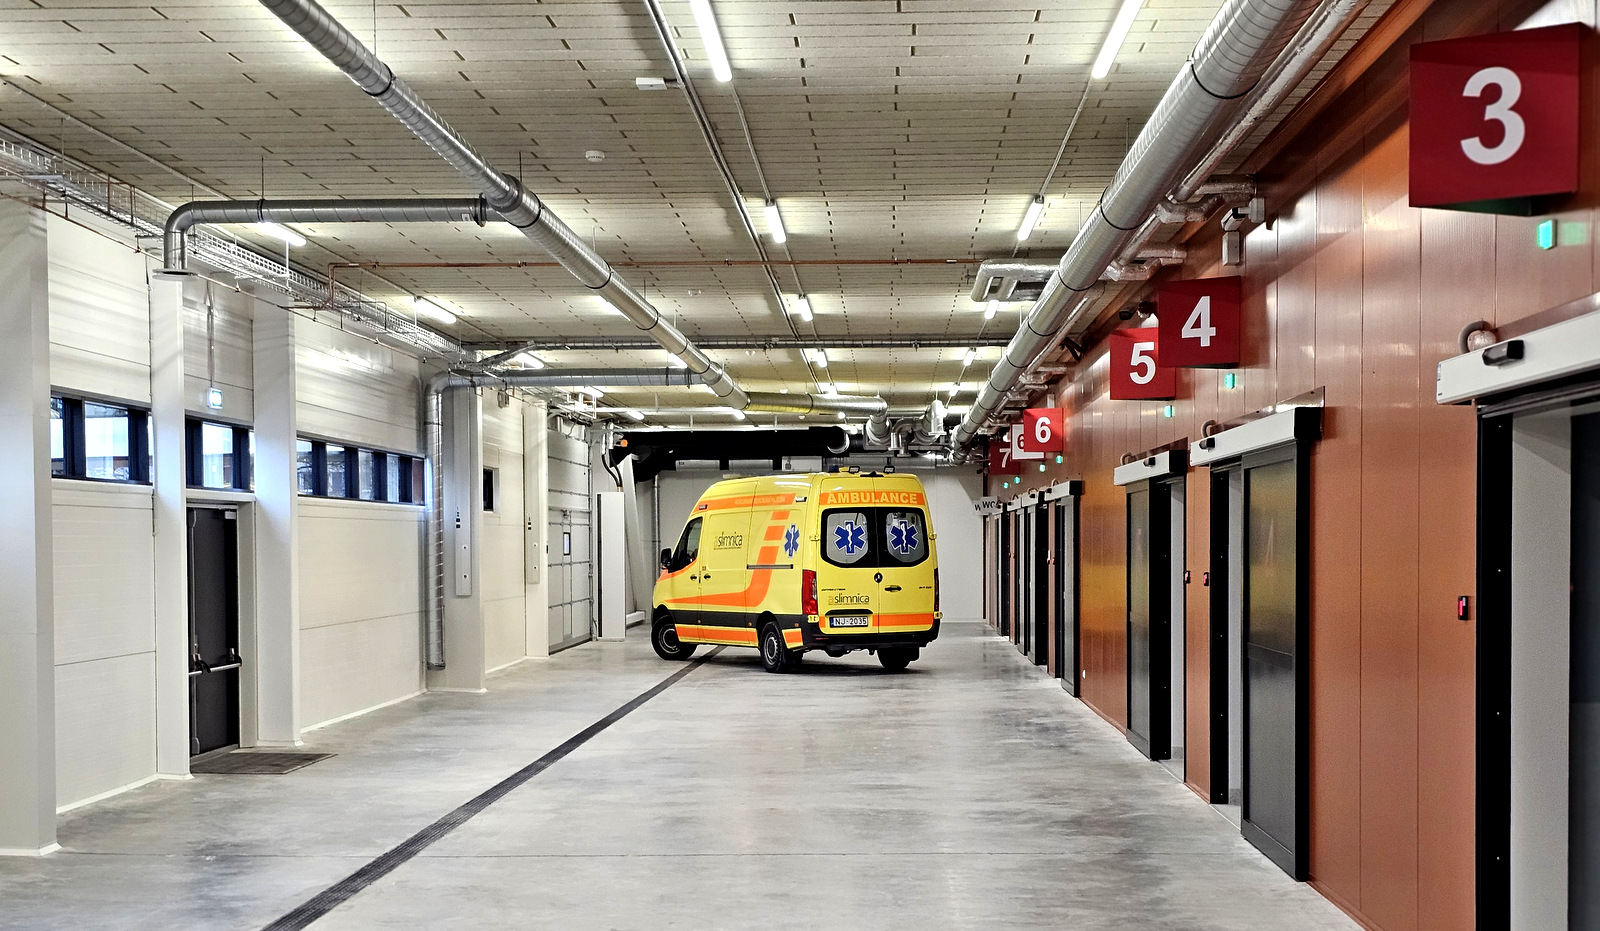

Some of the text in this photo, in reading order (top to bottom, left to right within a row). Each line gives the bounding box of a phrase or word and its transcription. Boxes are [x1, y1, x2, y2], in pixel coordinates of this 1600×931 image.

[1460, 66, 1525, 165] 3
[1181, 295, 1217, 347] 4
[1129, 341, 1156, 385] 5
[1035, 416, 1051, 443] 6
[999, 447, 1012, 468] 7
[826, 491, 918, 504] AMBULANCE
[835, 617, 867, 626] NJ-2035
